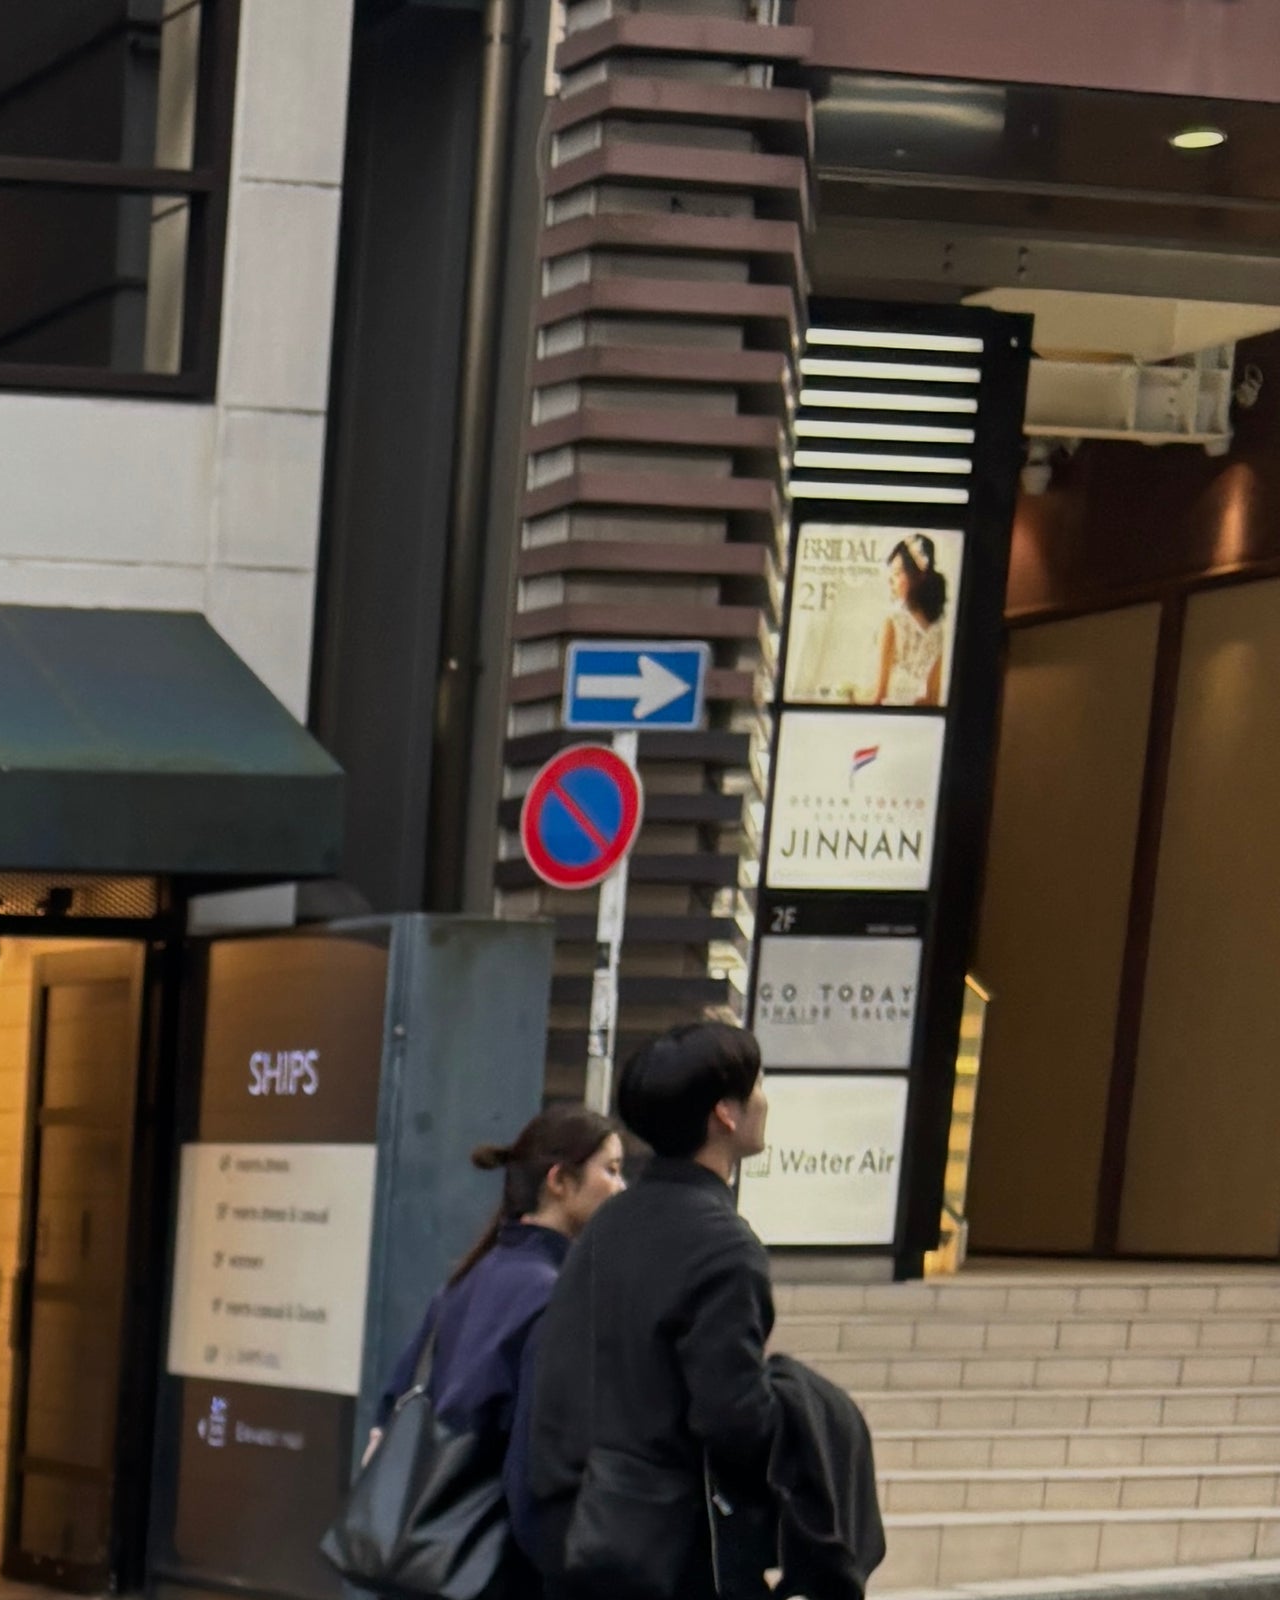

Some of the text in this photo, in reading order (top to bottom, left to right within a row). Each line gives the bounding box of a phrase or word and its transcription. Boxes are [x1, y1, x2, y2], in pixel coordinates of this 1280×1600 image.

[803, 538, 883, 563] BRIDAL
[799, 580, 838, 611] 2F
[780, 828, 922, 861] JINNAN
[771, 906, 798, 932] 2F
[759, 983, 912, 1003] GO TODAY
[248, 1049, 320, 1096] SHIPS
[780, 1149, 895, 1175] Water Air
